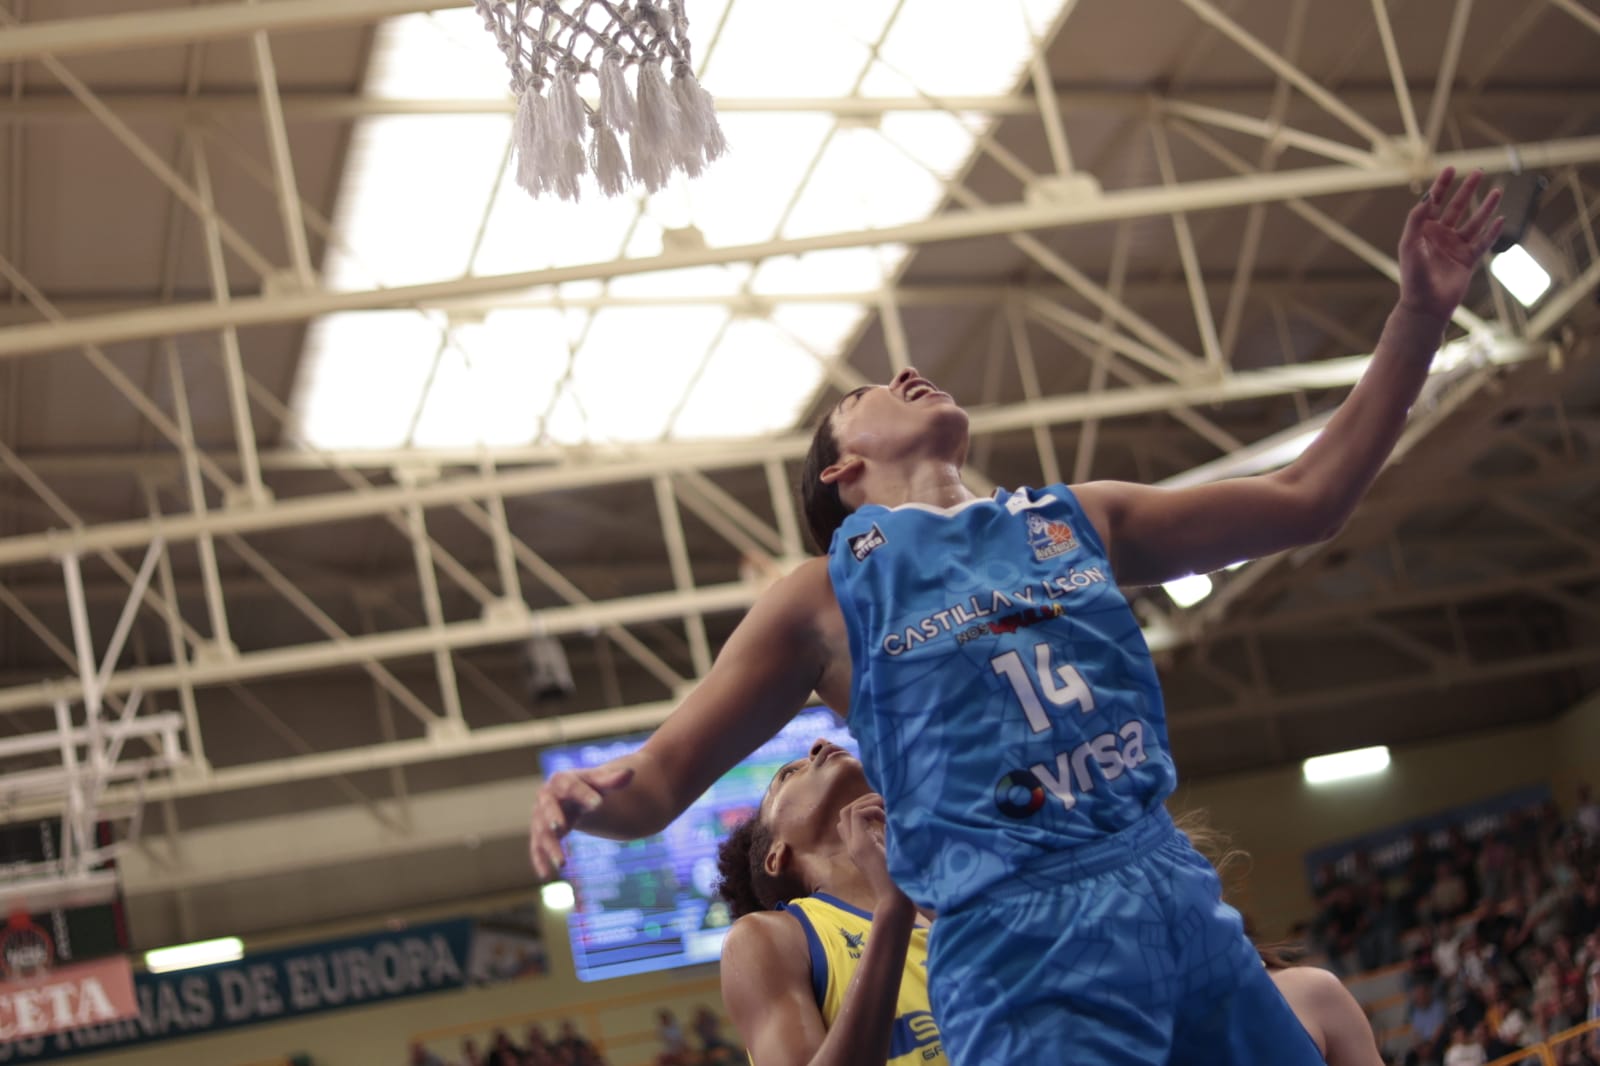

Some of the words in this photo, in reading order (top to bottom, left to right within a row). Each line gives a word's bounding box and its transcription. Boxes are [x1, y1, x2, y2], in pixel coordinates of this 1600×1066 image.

[883, 590, 1012, 656] CASTILLA
[1042, 567, 1106, 599] LEÓN
[991, 642, 1096, 735] 14
[219, 963, 283, 1020] DE
[286, 934, 461, 1008] EUROPA
